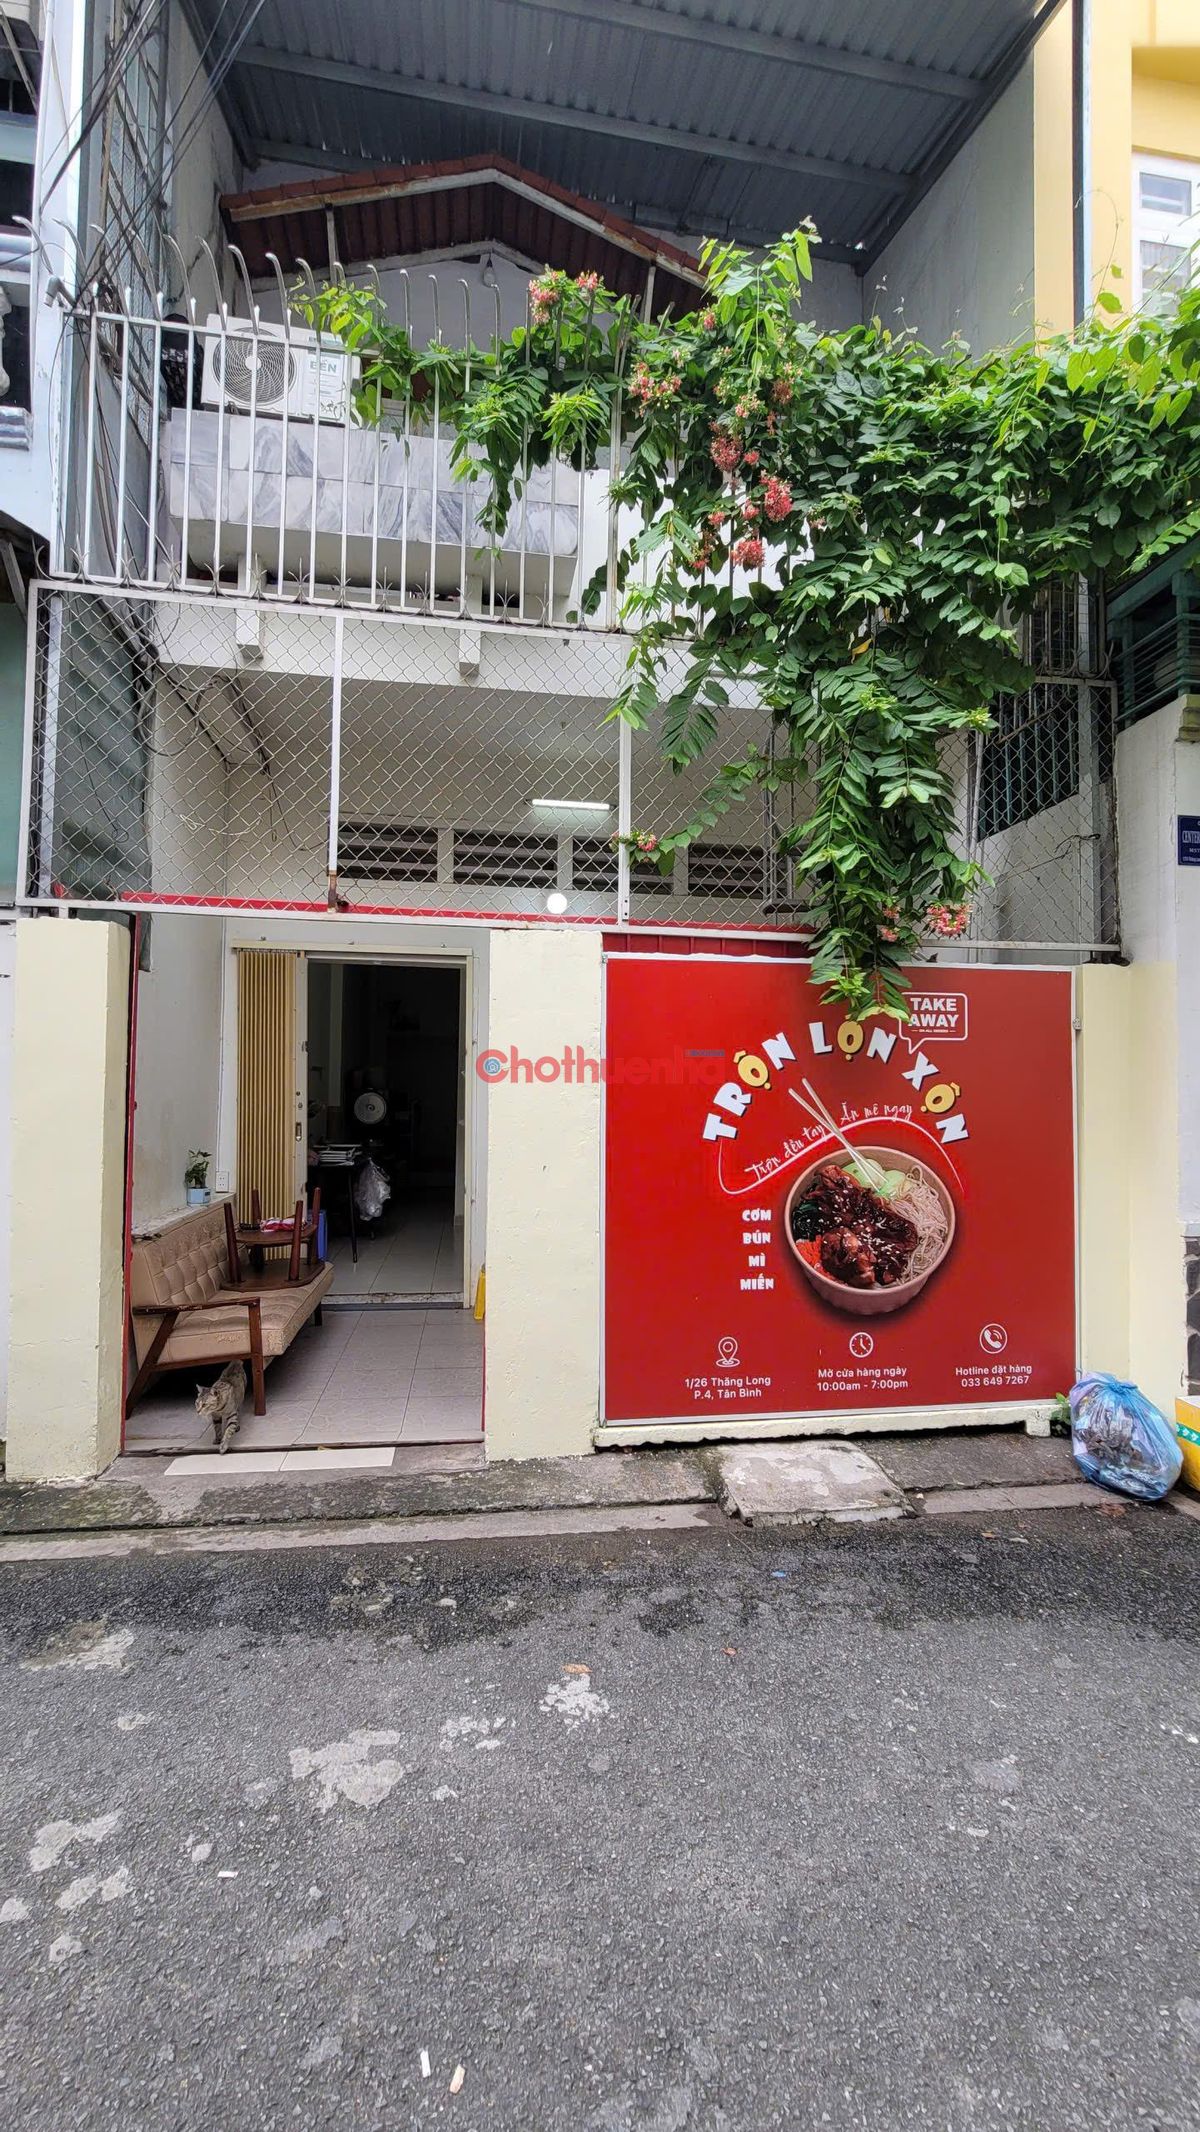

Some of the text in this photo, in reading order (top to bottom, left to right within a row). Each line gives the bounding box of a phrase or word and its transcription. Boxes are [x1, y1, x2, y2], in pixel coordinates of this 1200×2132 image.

[910, 998, 957, 1011] TAKE
[908, 1014, 959, 1027] AWAY
[703, 1032, 797, 1141] TRỘN
[902, 1052, 969, 1144] XỘN
[802, 1125, 826, 1141] tay
[884, 1105, 912, 1123] ngay
[743, 1230, 771, 1245] BÚN
[748, 1252, 766, 1267] MÌ
[740, 1273, 774, 1290] MIẾN
[856, 1367, 881, 1377] hàng
[883, 1366, 907, 1376] ngày
[955, 1367, 989, 1376] Hotline
[1009, 1365, 1032, 1375] hàng
[685, 1376, 771, 1389] 1/26 Thăng Long
[817, 1382, 860, 1391] 10:00am
[871, 1380, 908, 1389] 7:00pm
[961, 1375, 1030, 1387] 033 649 7267
[694, 1388, 762, 1400] P.4, Tân Bình
